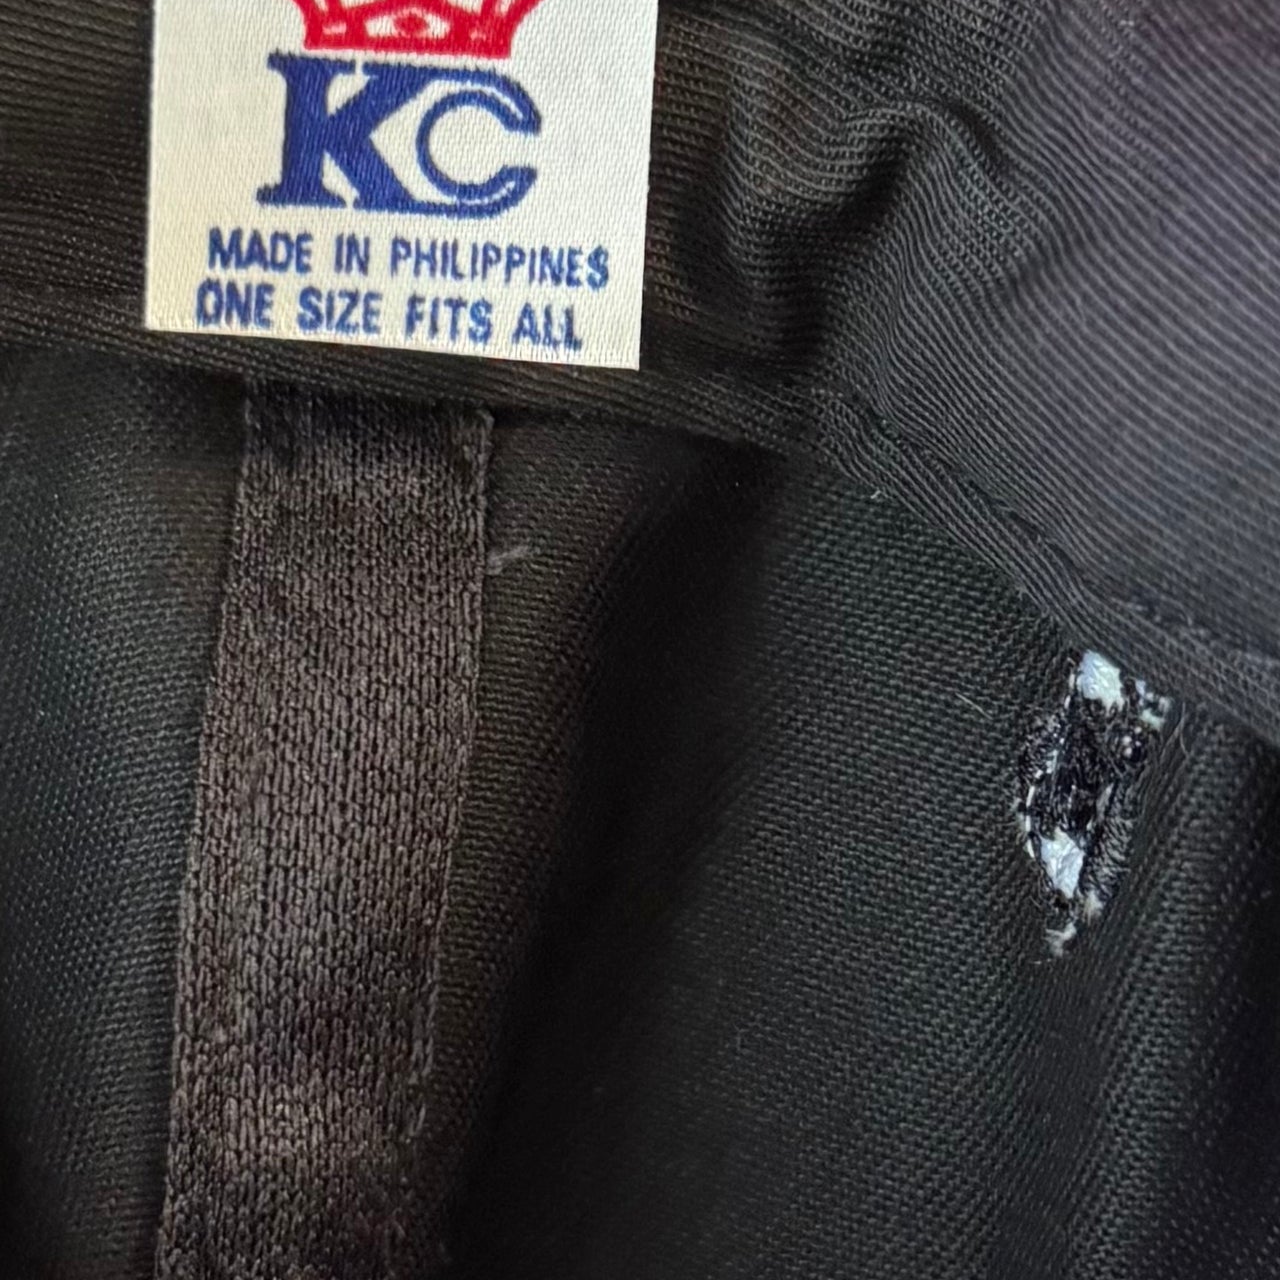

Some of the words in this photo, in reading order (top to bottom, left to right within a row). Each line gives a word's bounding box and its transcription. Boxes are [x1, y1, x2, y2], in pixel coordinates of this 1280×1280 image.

[255, 51, 542, 220] KC
[207, 230, 313, 277] MADE
[333, 235, 371, 276] IN
[388, 239, 611, 293] PHILIPPINES
[195, 280, 275, 330] ONE
[296, 286, 382, 336] SIZE
[404, 297, 493, 345] FITS
[511, 303, 583, 352] ALL
